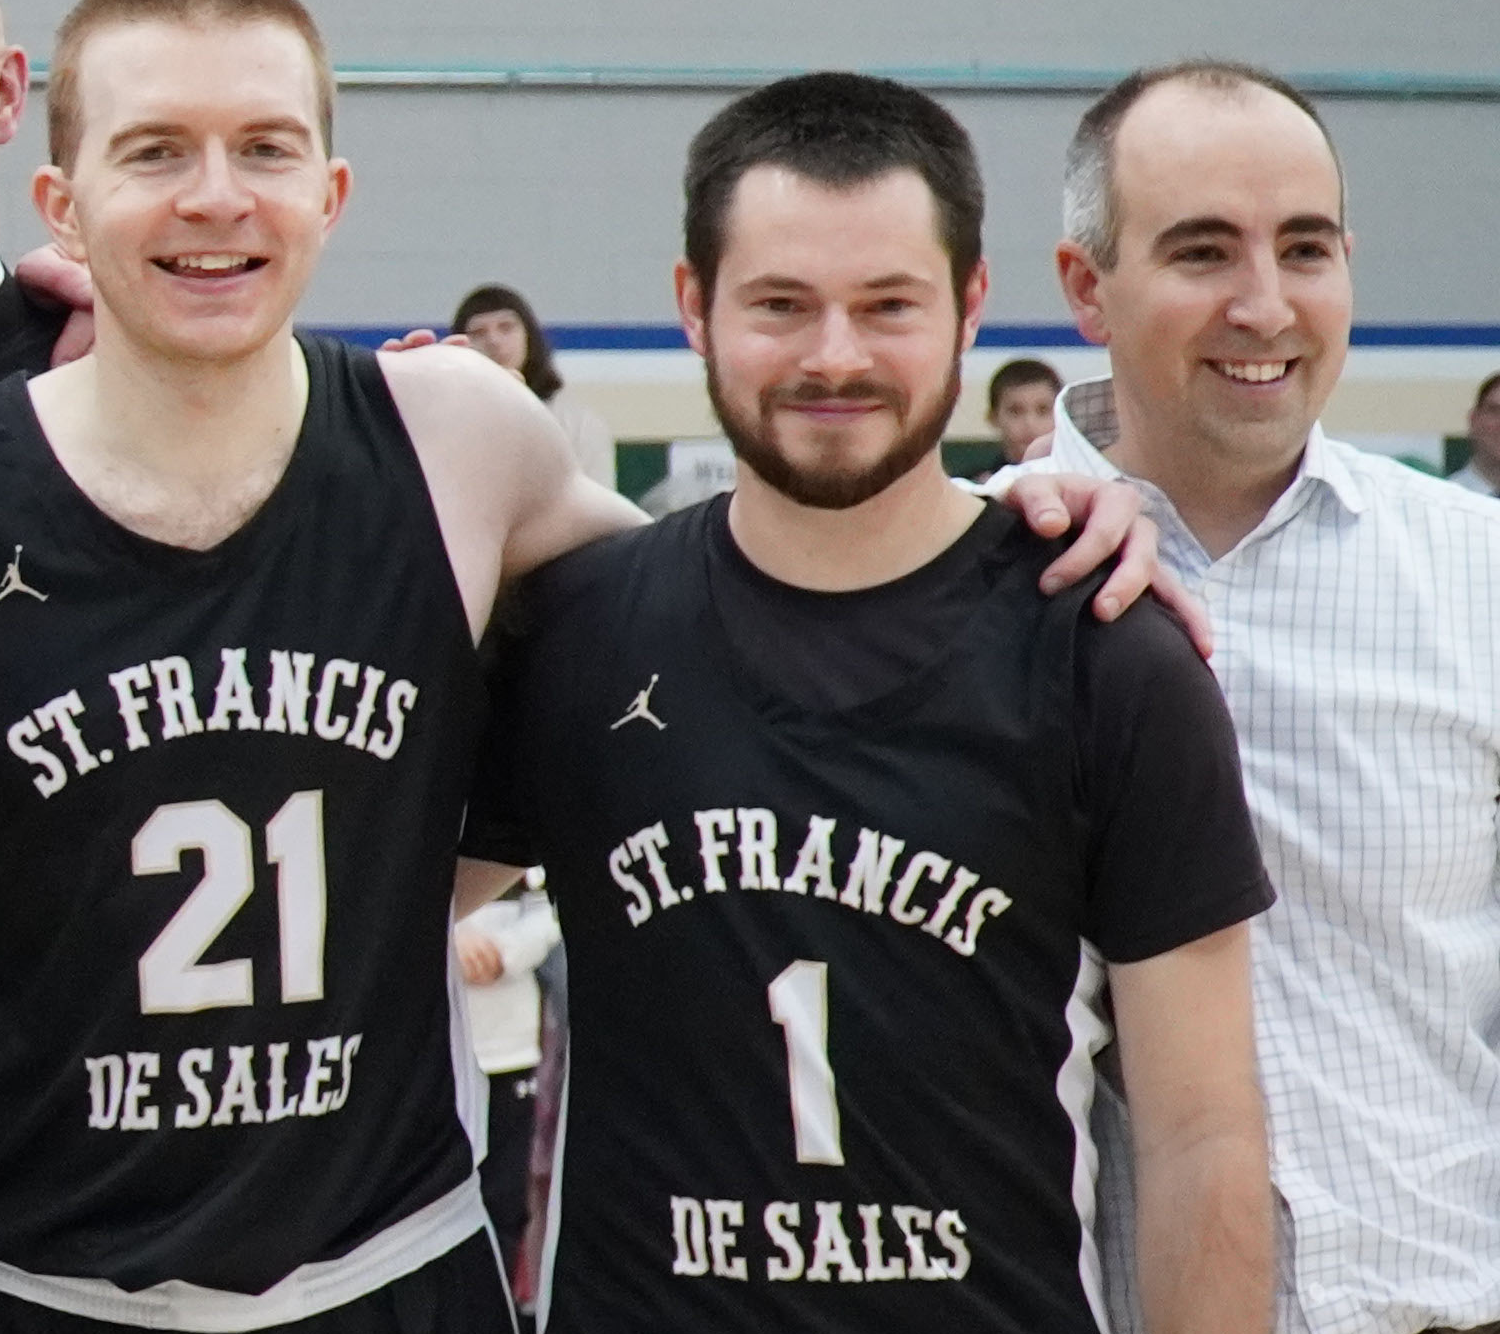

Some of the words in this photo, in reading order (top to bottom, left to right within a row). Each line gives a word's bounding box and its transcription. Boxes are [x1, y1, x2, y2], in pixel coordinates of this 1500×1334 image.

[7, 690, 113, 799] ST.
[108, 648, 417, 760] FRANCIS
[132, 789, 327, 1015] 21
[609, 821, 694, 927] ST.
[694, 807, 1012, 956] FRANCIS
[85, 1052, 160, 1131] DE
[175, 1034, 362, 1129] SALES
[768, 959, 845, 1166] 1
[671, 1195, 748, 1281] DE
[764, 1201, 971, 1283] SALES
